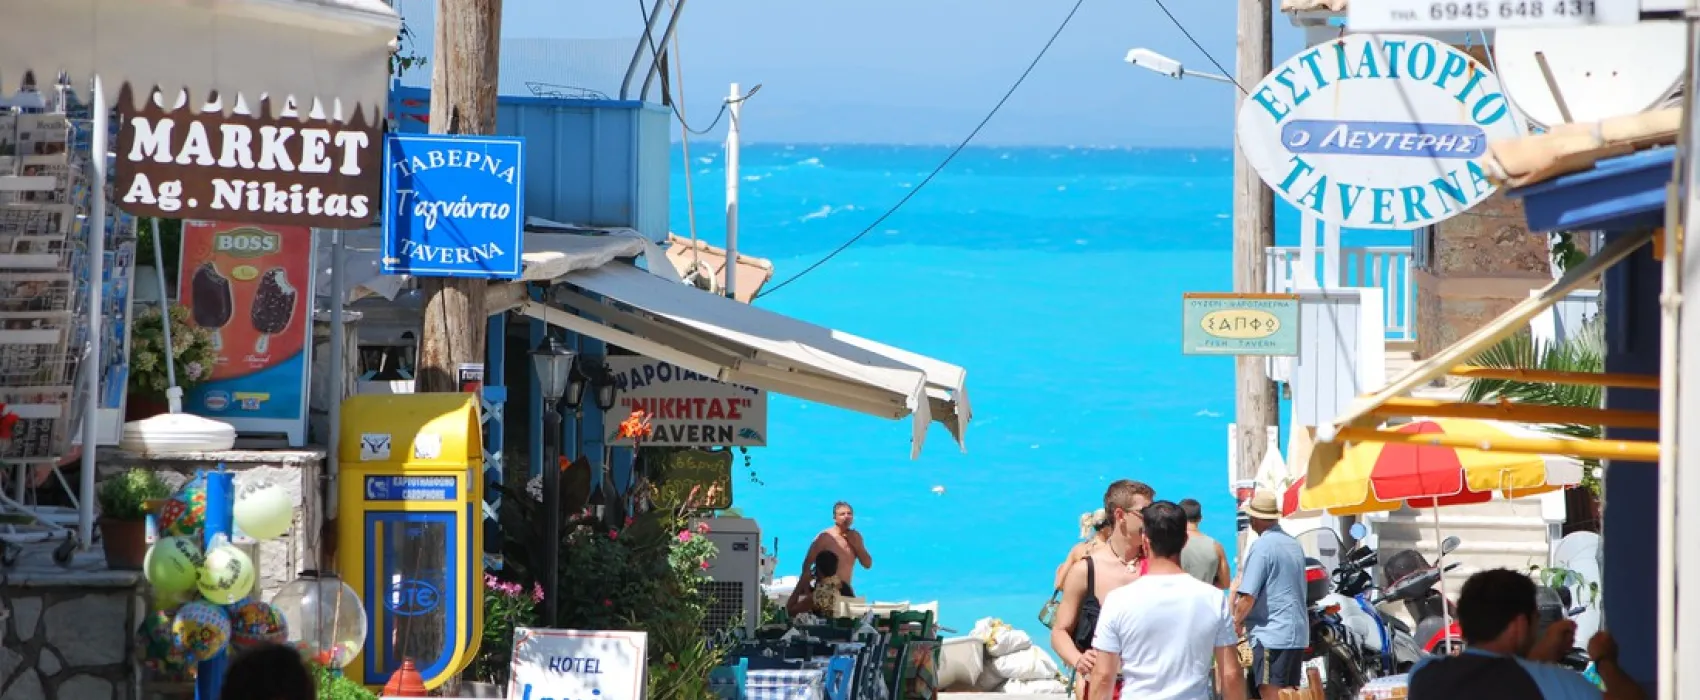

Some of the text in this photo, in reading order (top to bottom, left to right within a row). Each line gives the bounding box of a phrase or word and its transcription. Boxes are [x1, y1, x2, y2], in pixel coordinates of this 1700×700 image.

[1430, 2, 1489, 21] 6945
[1499, 1, 1543, 19] 648
[1553, 0, 1596, 17] 431
[1252, 40, 1508, 125] ΕΣΤΙΑΤΟΡΙΟ
[127, 116, 369, 176] MARKET
[393, 149, 515, 184] ΤΑΒΕΡΝΑ
[123, 172, 369, 218] Ag. Nikitas
[1276, 156, 1493, 225] TAVERNA
[217, 235, 274, 251] BOSS
[400, 238, 504, 264] TAVERNA
[641, 424, 733, 443] AVERN
[548, 656, 603, 674] HOTEL
